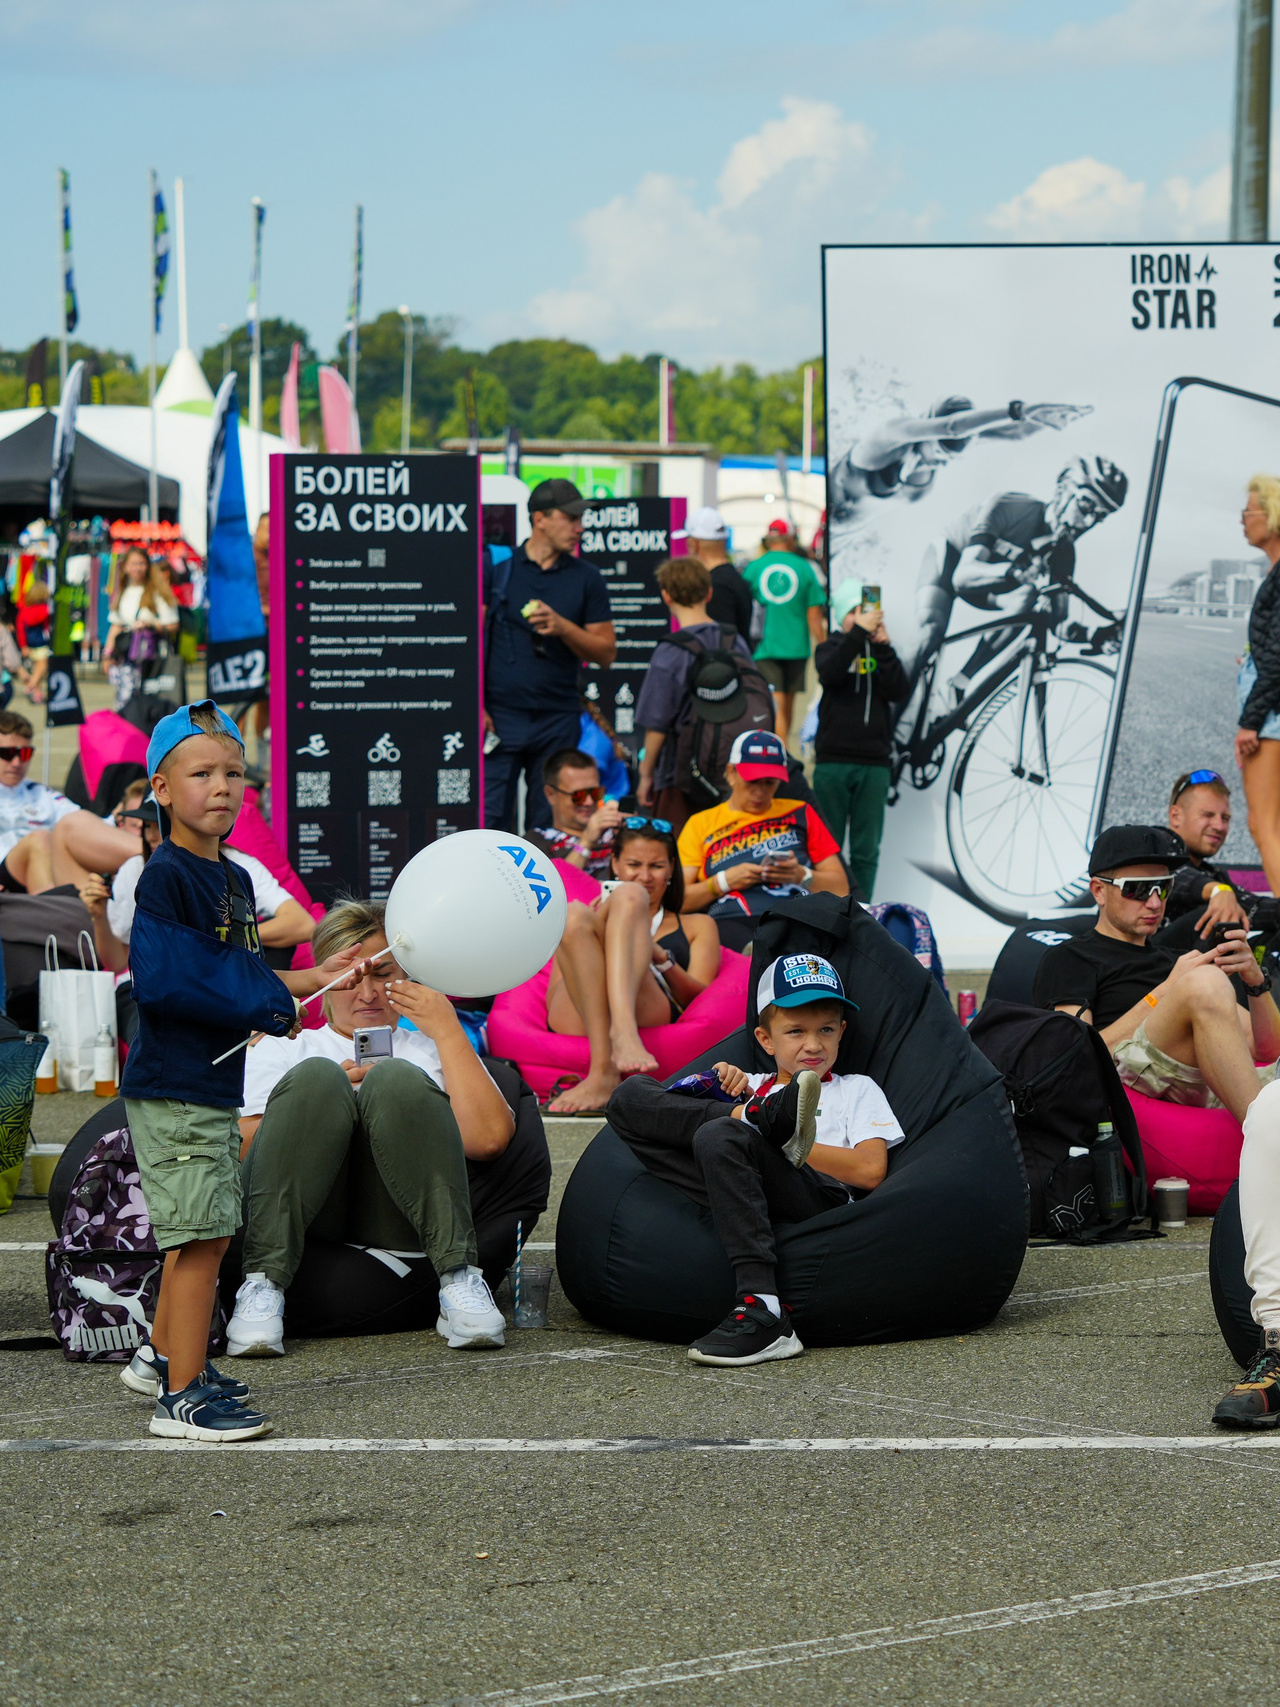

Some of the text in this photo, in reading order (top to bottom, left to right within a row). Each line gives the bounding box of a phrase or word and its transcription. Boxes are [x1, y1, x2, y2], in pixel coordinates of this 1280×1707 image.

[1131, 254, 1190, 284] IRON
[1131, 289, 1217, 329] STAR
[294, 460, 410, 495] БОЛЕЙ
[294, 502, 468, 532] ЗА СВОИХ
[581, 529, 668, 552] ЗА СВОИХ
[496, 845, 552, 915] AVA
[69, 1323, 140, 1351] PUMA
